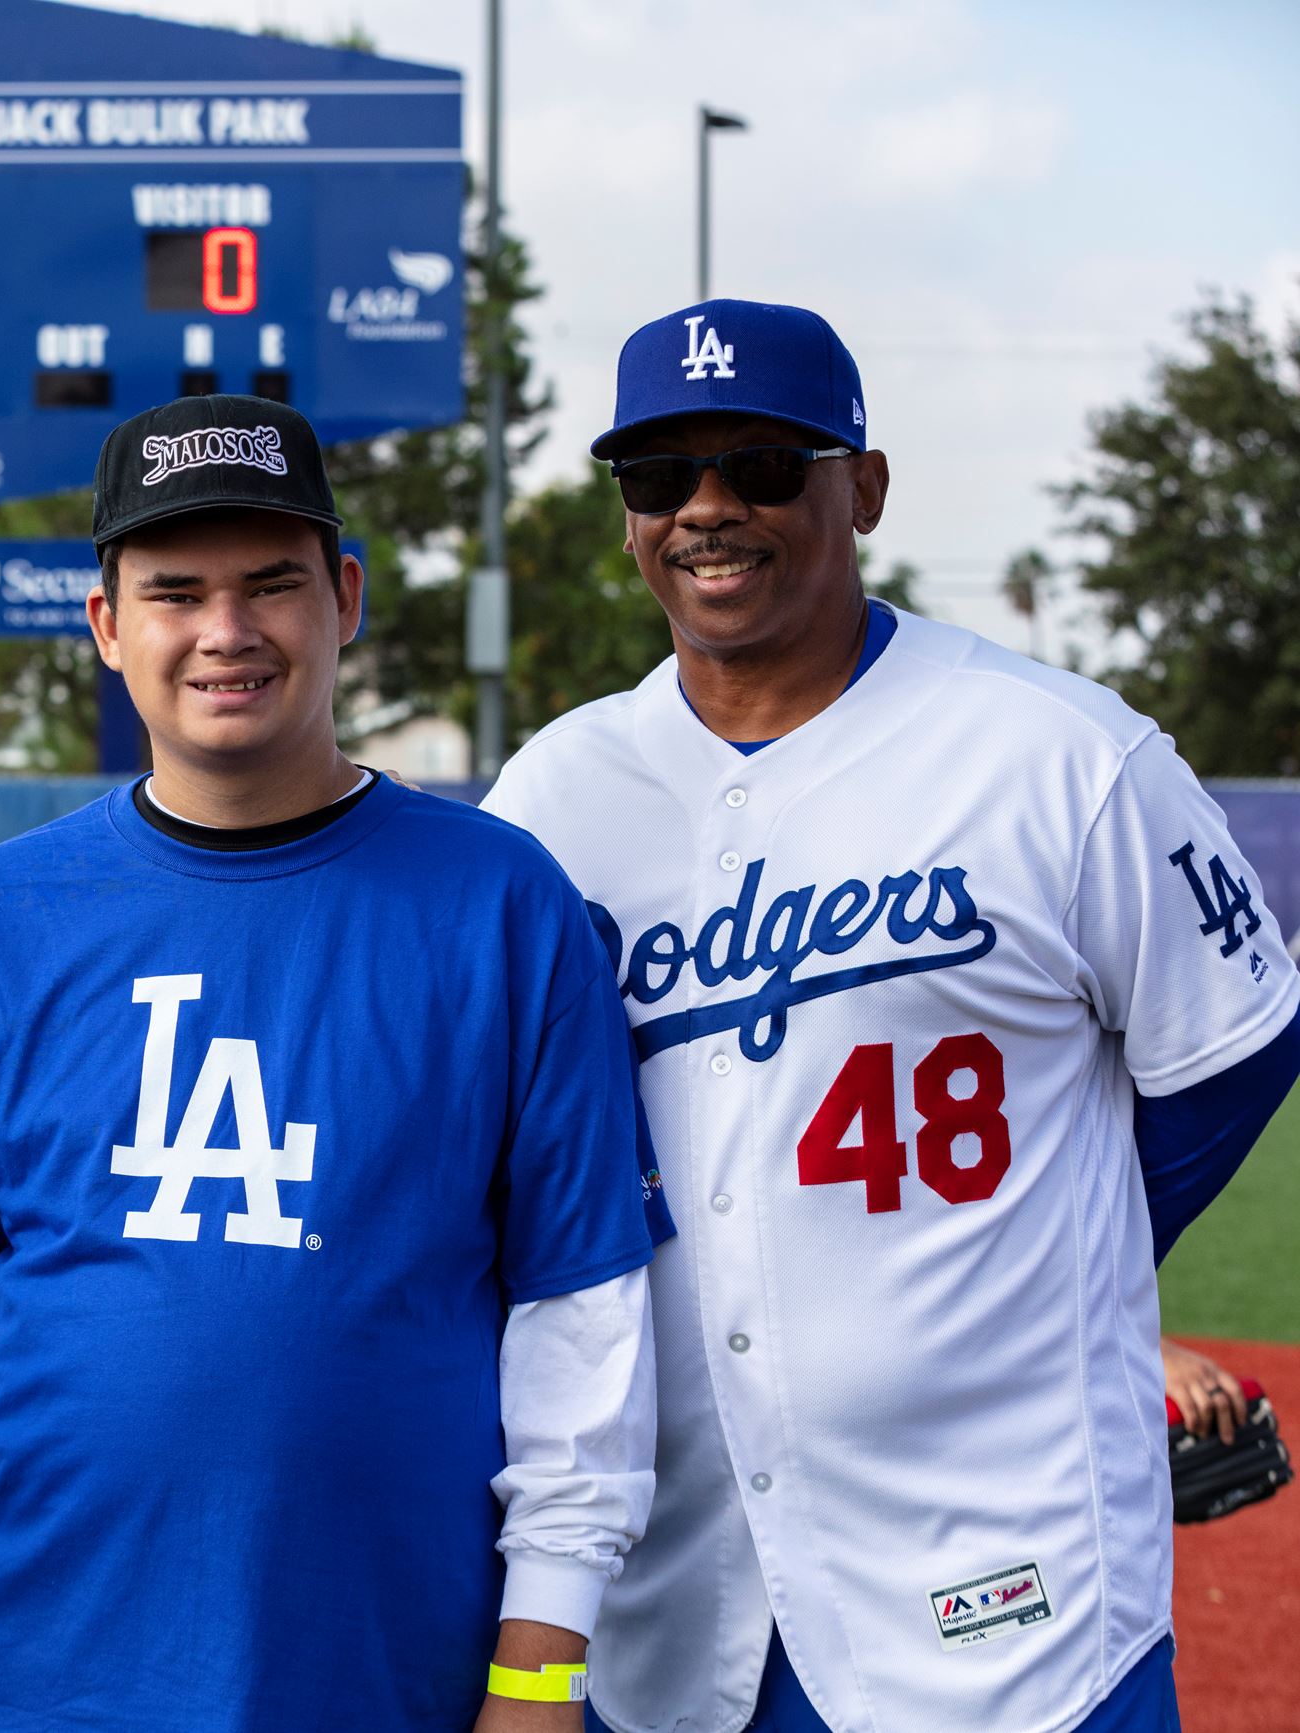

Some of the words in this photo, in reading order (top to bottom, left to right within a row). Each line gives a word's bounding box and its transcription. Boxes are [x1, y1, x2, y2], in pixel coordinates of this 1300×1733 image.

[209, 100, 309, 145] PARK
[133, 184, 271, 227] VISITOR
[202, 227, 258, 315] 0
[37, 324, 108, 367] OUT
[681, 315, 736, 381] LA
[162, 431, 268, 471] MALOSOS
[1168, 840, 1262, 958] LA
[110, 974, 317, 1249] LA
[797, 1032, 1012, 1214] 48
